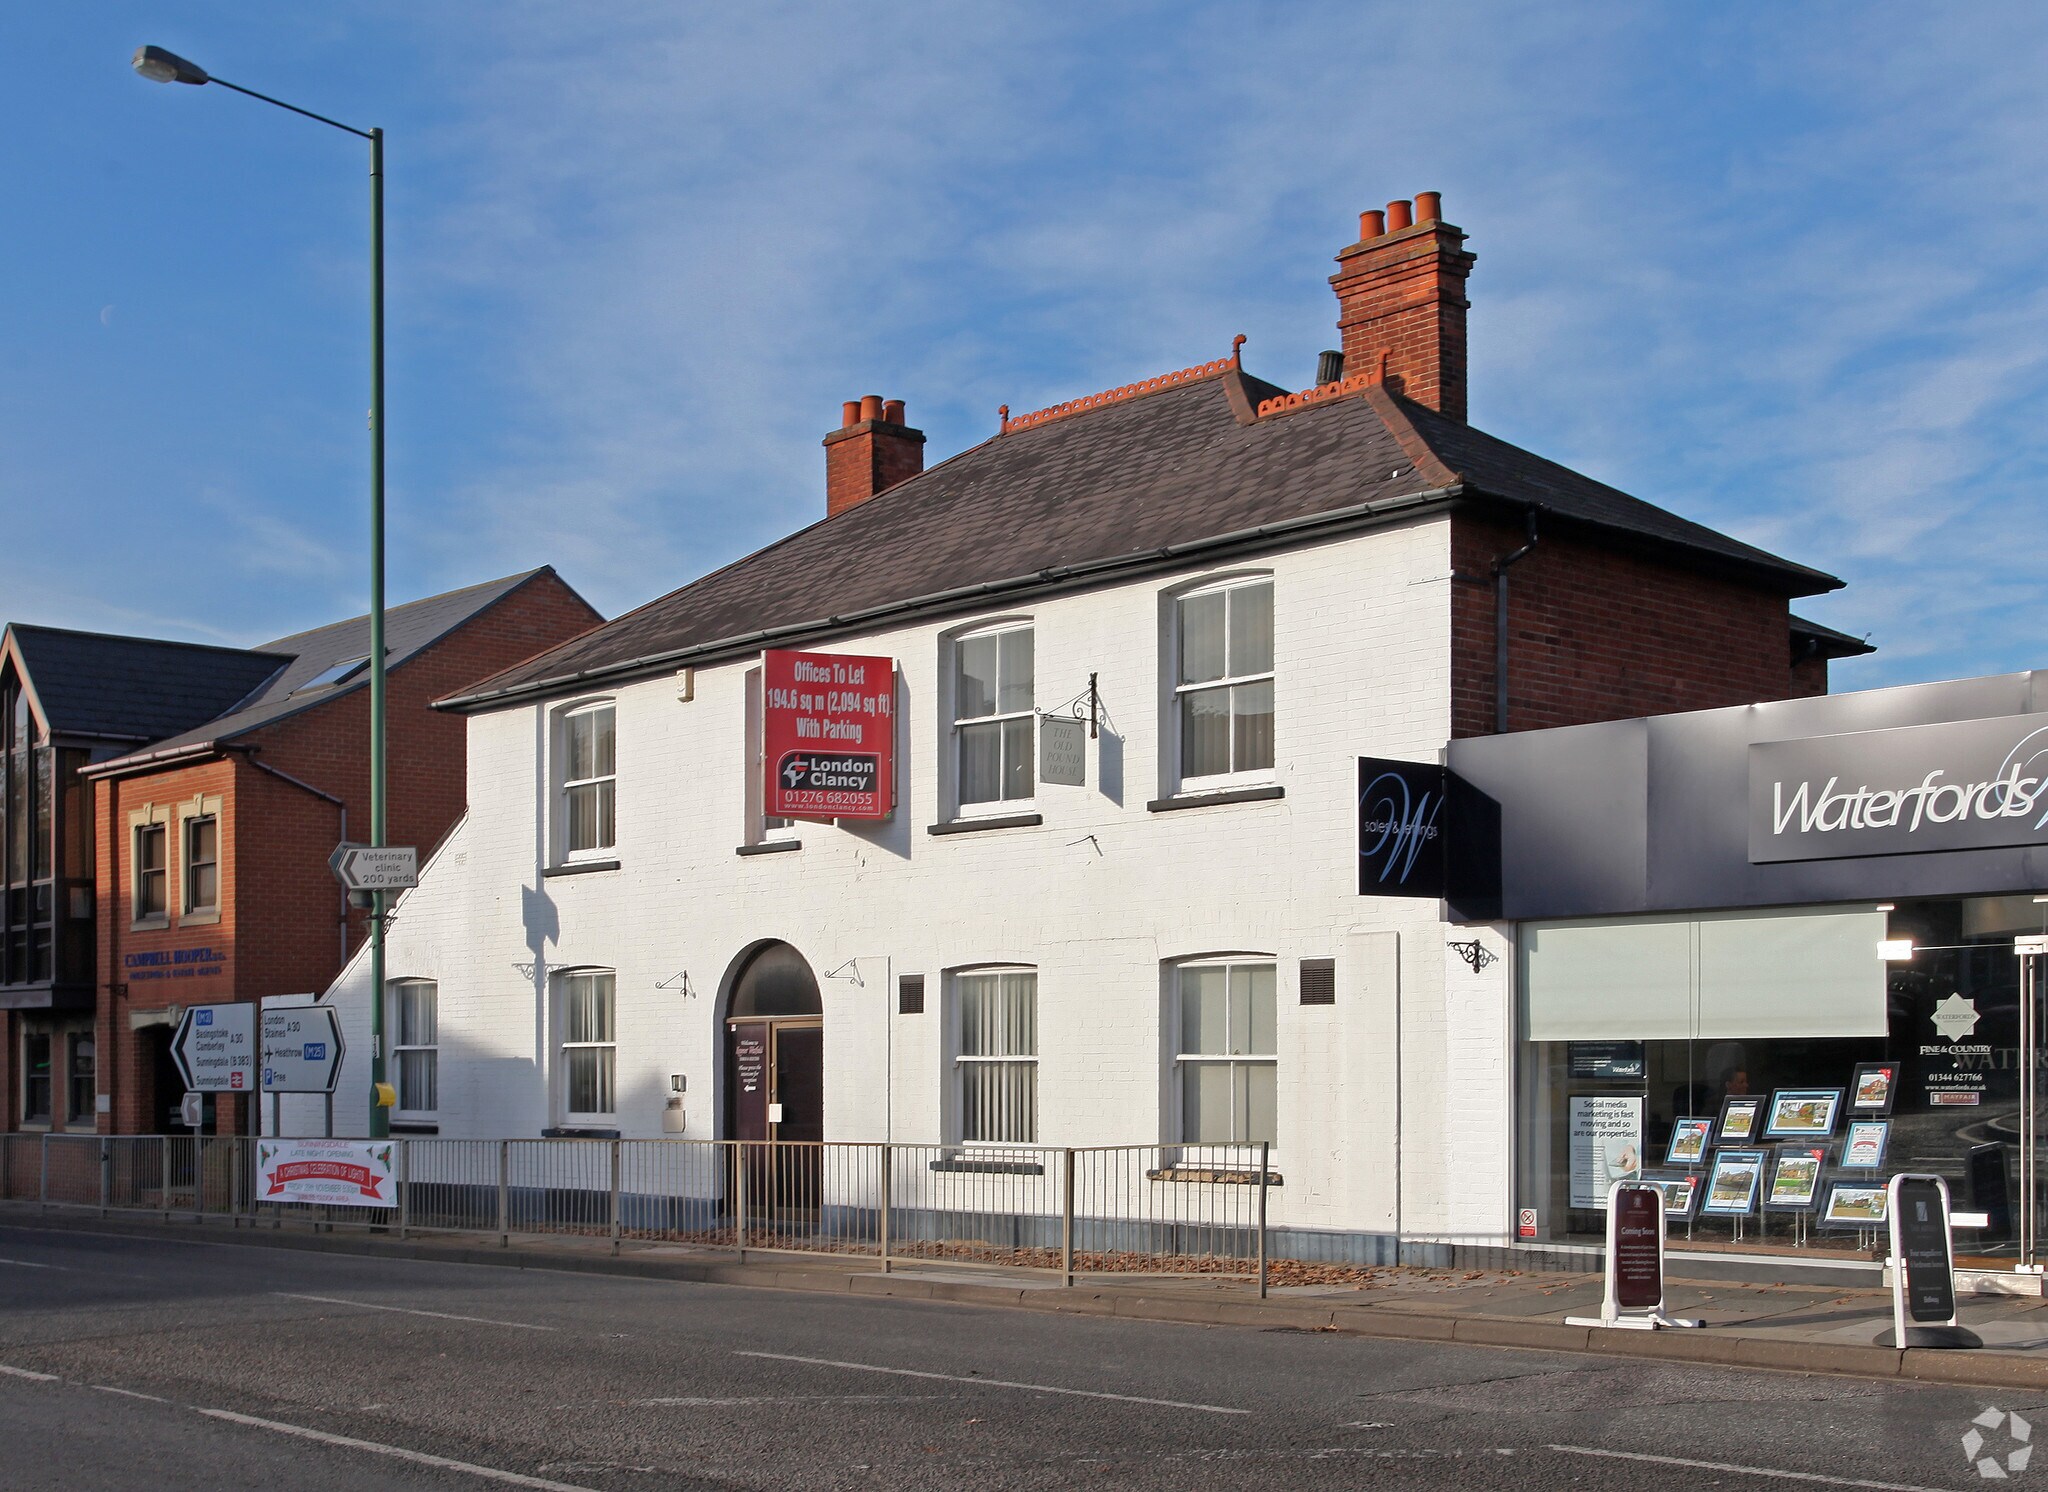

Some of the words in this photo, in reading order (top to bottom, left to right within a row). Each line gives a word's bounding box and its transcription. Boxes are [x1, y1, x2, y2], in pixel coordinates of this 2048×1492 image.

[794, 661, 831, 683] Offices
[833, 663, 845, 684] To
[849, 665, 865, 685] Let
[768, 688, 797, 710] 194.6
[800, 693, 812, 714] sq
[815, 694, 824, 711] m
[828, 691, 861, 715] (2,094
[863, 697, 876, 717] sq
[796, 717, 820, 738] With
[823, 719, 863, 744] Parking
[1053, 727, 1072, 739] THE
[1053, 740, 1073, 752] OLD
[1046, 751, 1080, 764] POUND
[810, 758, 875, 773] London
[1048, 764, 1077, 777] HOUSE
[810, 773, 868, 790] Clancy
[784, 791, 824, 804] 01276
[827, 792, 873, 805] 682055
[1772, 763, 2039, 835] Waterfords
[784, 802, 874, 812] www.londonclancy.com
[1364, 820, 1389, 833] sales
[1392, 821, 1400, 834] &
[362, 852, 413, 862] Veterinary
[375, 863, 401, 872] clinic
[363, 874, 384, 883] 200
[387, 874, 415, 884] yards
[264, 1014, 285, 1025] London
[196, 1028, 229, 1040] Basingstoke
[264, 1028, 286, 1038] Staines
[196, 1041, 225, 1052] Camberley
[1919, 1045, 1941, 1055] FINE
[1940, 1046, 1948, 1054] &
[1948, 1044, 1992, 1055] COUNTRY
[274, 1047, 302, 1058] Heathrow
[196, 1056, 229, 1068] Sunningdale
[196, 1075, 229, 1087] Sunningdale
[273, 1071, 286, 1081] Free
[1928, 1073, 1952, 1082] 01344
[1953, 1073, 1983, 1081] 627766
[1583, 1100, 1604, 1108] Social
[1605, 1100, 1628, 1109] media
[1577, 1110, 1613, 1120] marketing
[1613, 1110, 1620, 1118] is
[1620, 1110, 1634, 1119] fast
[1580, 1120, 1607, 1129] moving
[1607, 1120, 1621, 1128] and
[1598, 1129, 1638, 1138] properties!
[327, 1150, 354, 1158] OPENING
[1621, 1226, 1641, 1237] Coming
[1641, 1227, 1655, 1236] Soon
